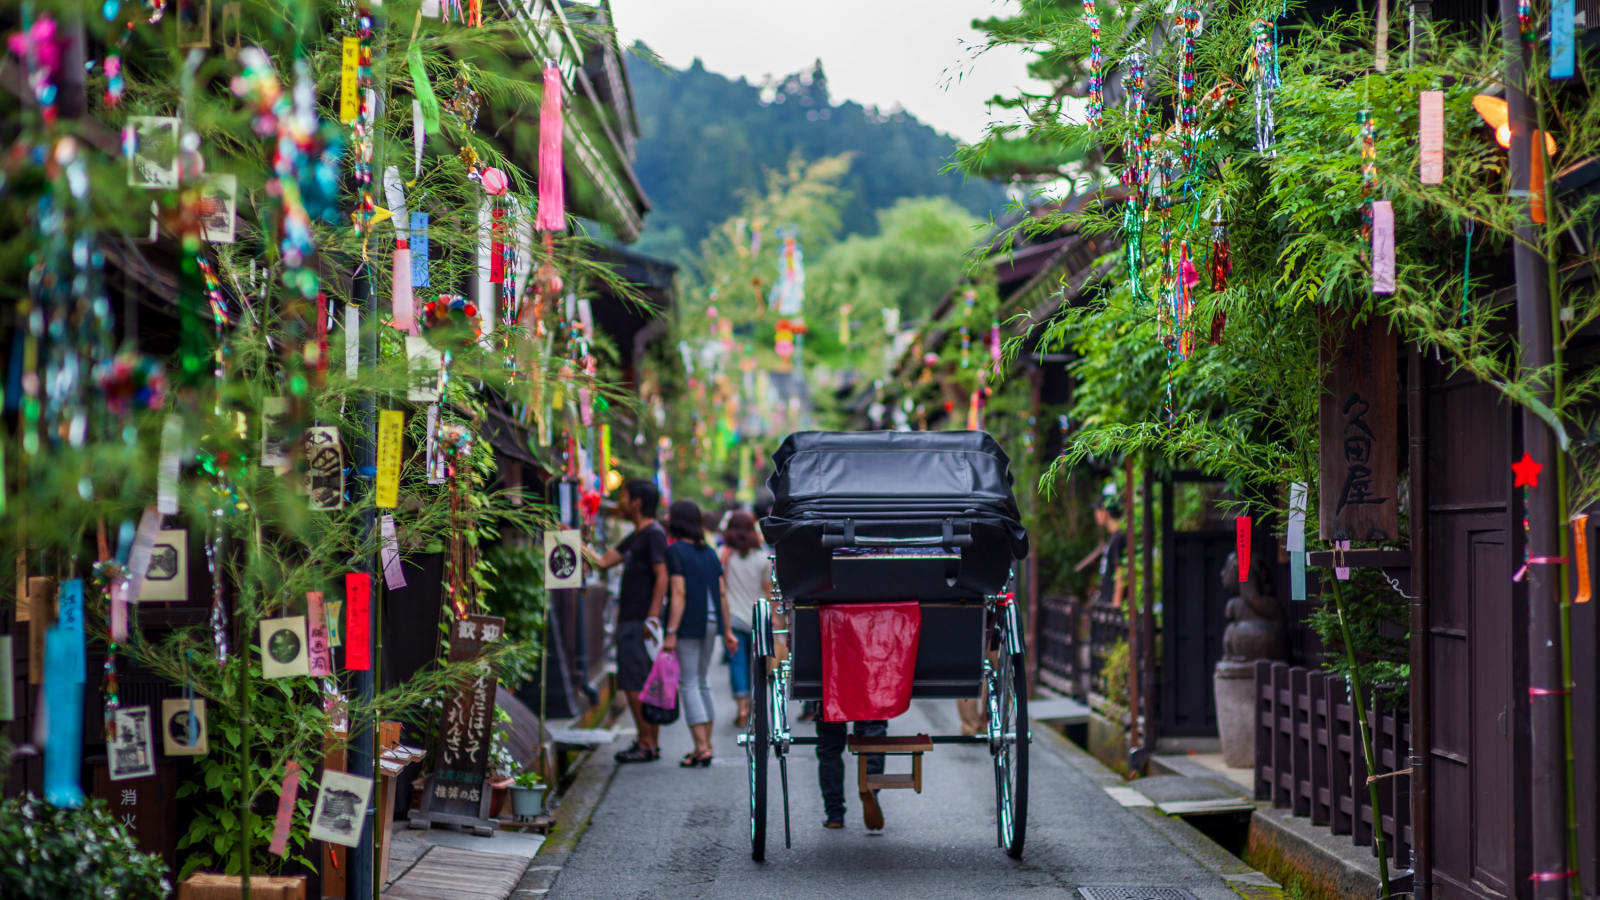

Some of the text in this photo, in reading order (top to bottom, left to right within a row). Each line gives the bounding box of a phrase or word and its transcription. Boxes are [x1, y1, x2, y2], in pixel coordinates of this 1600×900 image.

[1336, 392, 1389, 516] 久田屋
[457, 620, 500, 642] 歓迎
[121, 789, 137, 848] 消火
